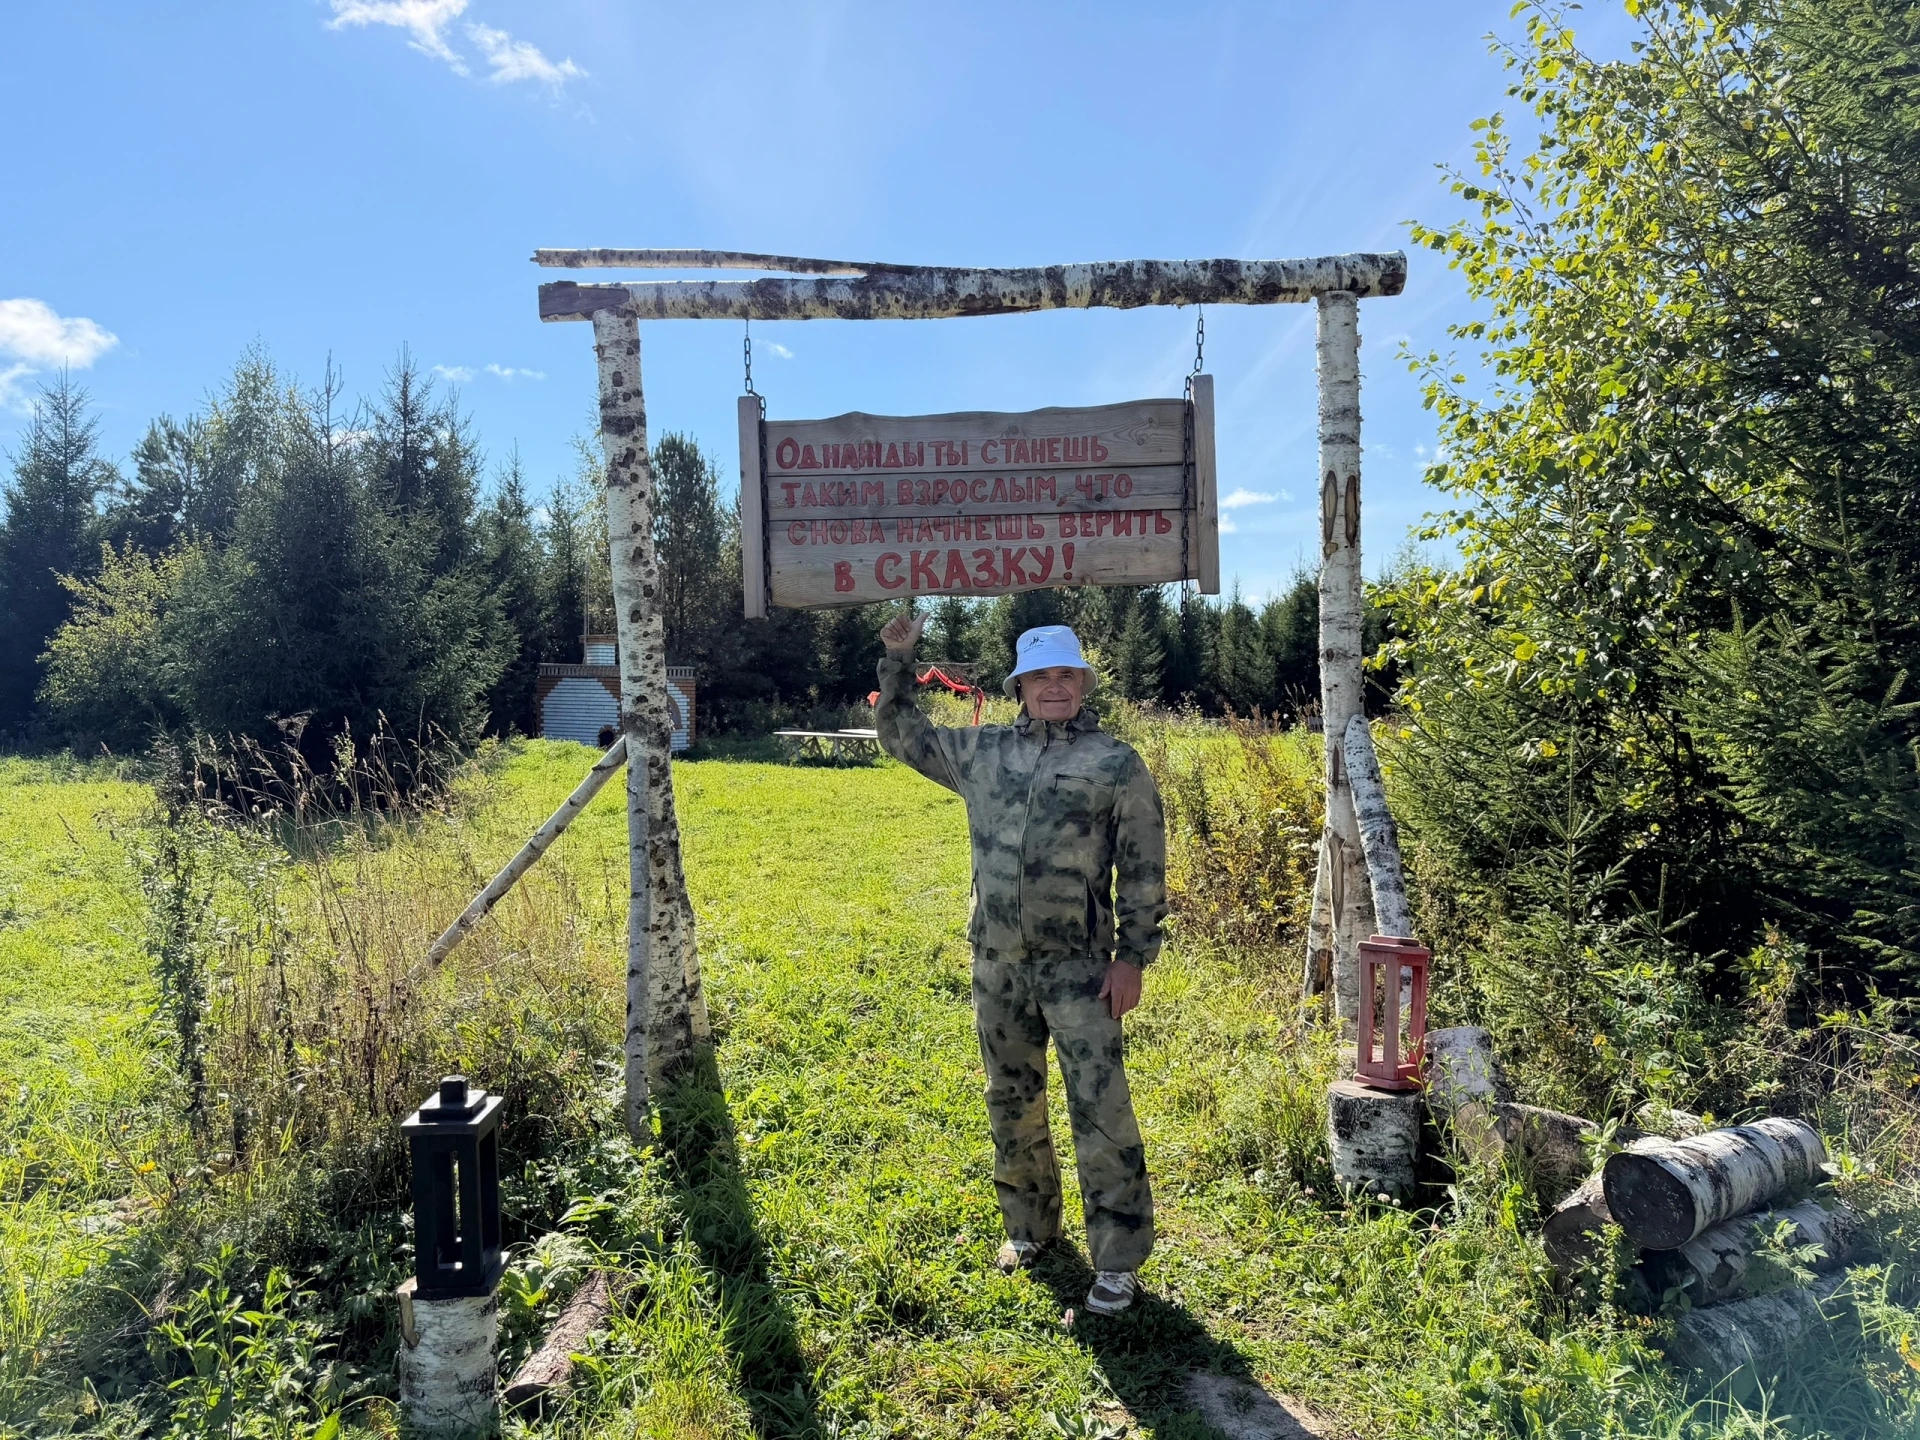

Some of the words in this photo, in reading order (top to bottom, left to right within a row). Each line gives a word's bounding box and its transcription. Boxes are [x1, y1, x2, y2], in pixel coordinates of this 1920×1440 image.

[928, 440, 969, 466] ТЫ
[980, 436, 1109, 464] СТАНЕШЬ
[781, 481, 885, 508] ТАКИМ
[897, 475, 1067, 508] ВЗРОСЛЫМ,
[1075, 473, 1133, 499] ЧТО
[788, 519, 885, 546] СНОВА
[896, 515, 1045, 543] НАЧНЕШЬ
[1058, 511, 1172, 538] ВЕРИТЬ
[875, 542, 1075, 590] СКАЗКУ!
